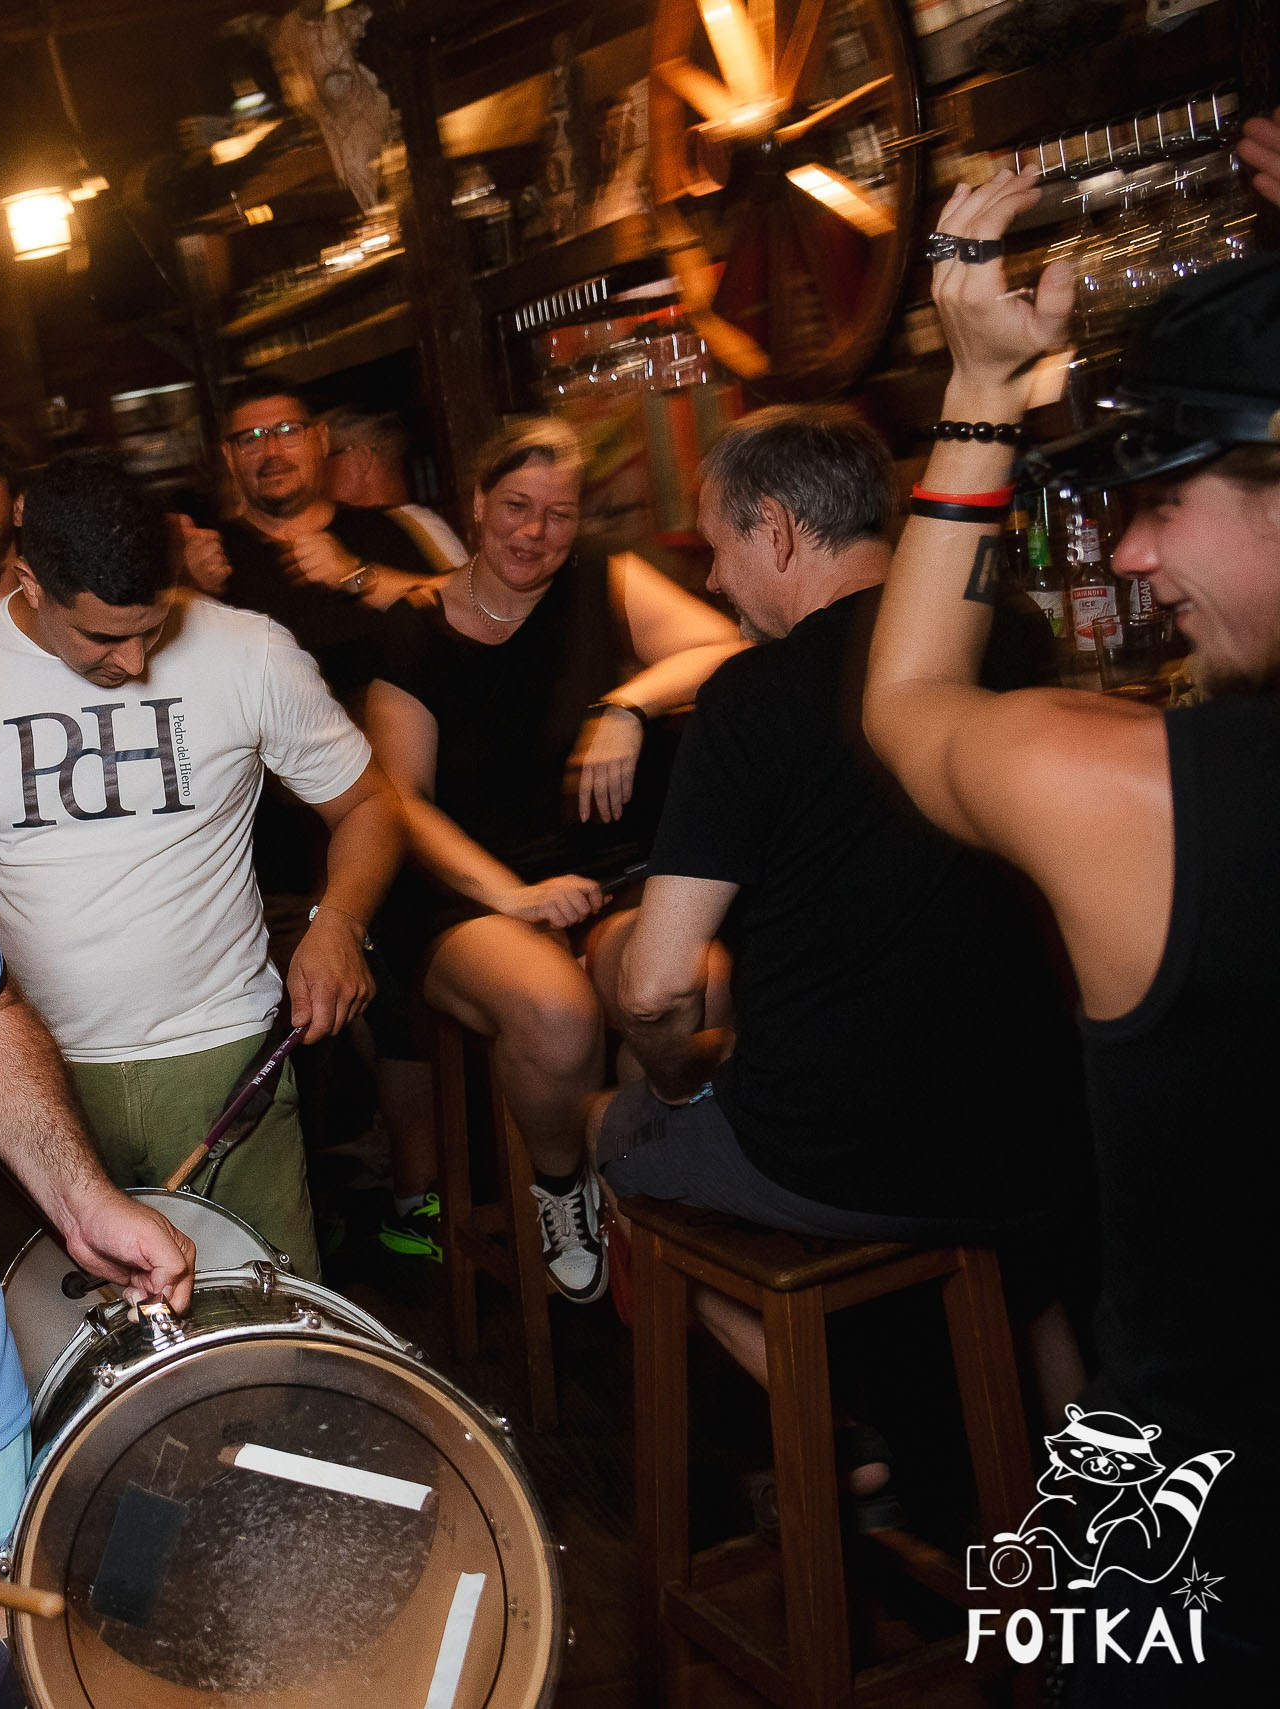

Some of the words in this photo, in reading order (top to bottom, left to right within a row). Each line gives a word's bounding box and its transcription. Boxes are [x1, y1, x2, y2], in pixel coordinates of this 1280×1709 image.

[172, 714, 186, 746] Pedro
[178, 745, 188, 765] del
[179, 764, 193, 798] Hierro
